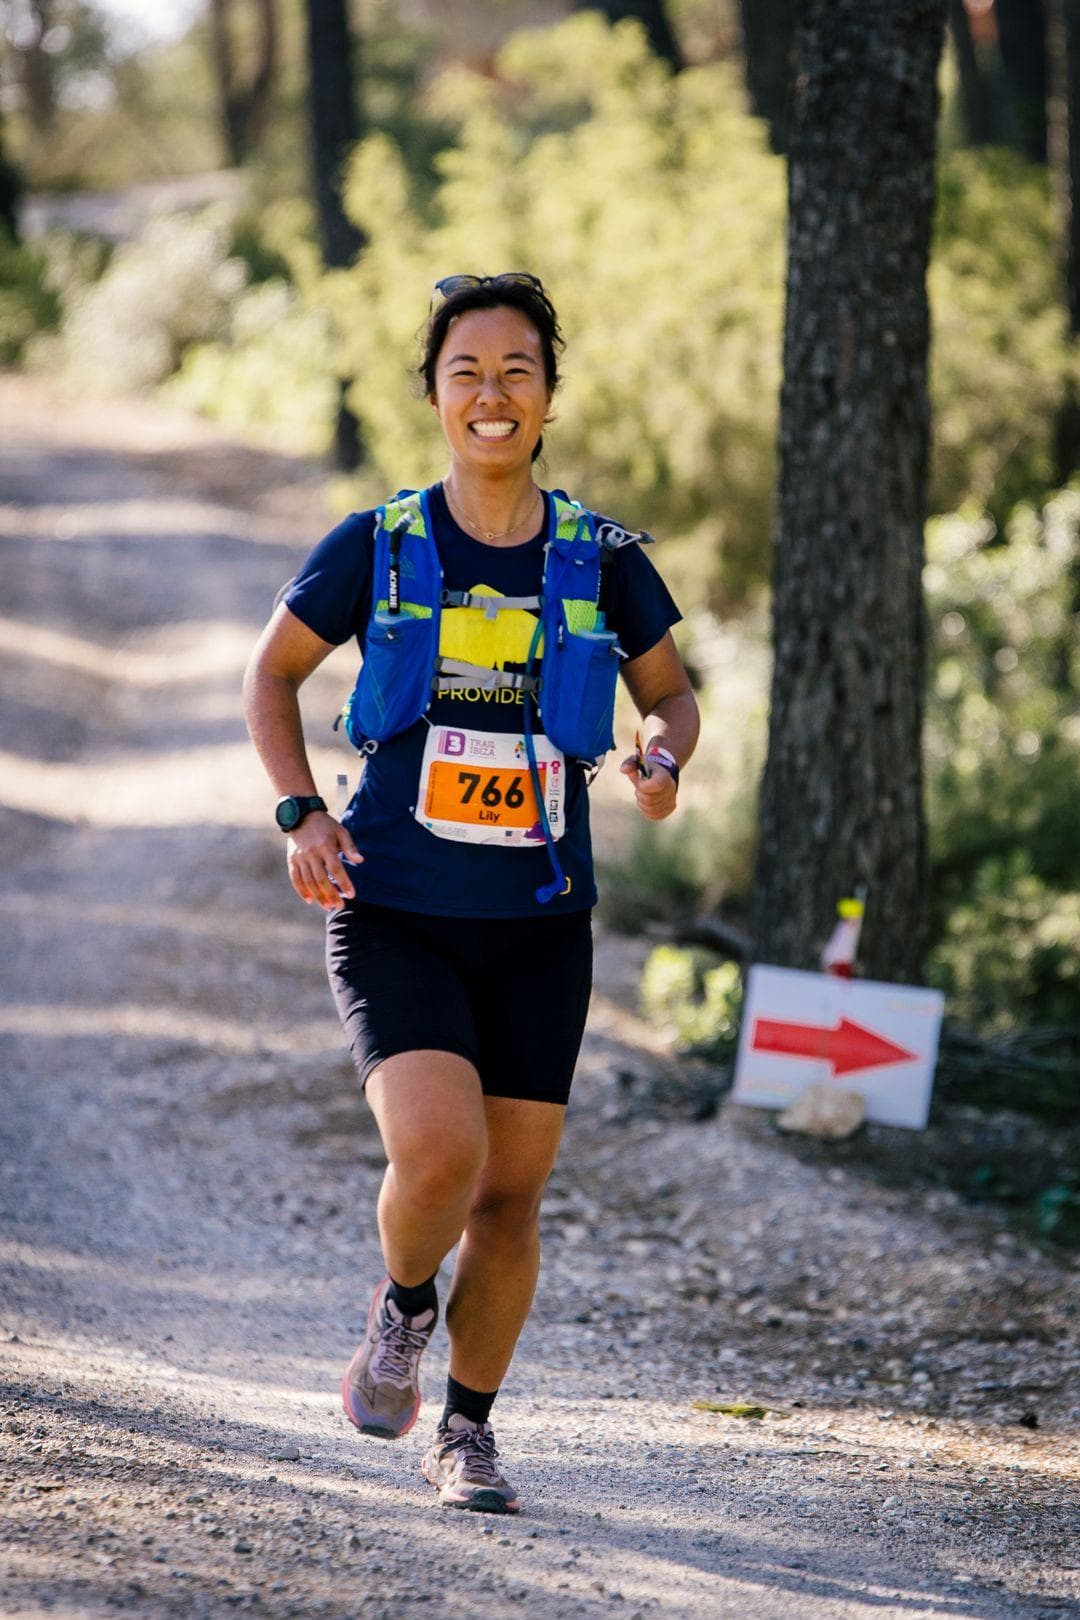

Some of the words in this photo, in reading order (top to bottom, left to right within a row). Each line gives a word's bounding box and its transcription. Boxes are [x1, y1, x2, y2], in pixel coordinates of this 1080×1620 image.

[469, 738, 496, 748] TRAIL
[470, 746, 495, 756] IBIZA
[458, 771, 525, 809] 766
[478, 810, 500, 823] Lily
